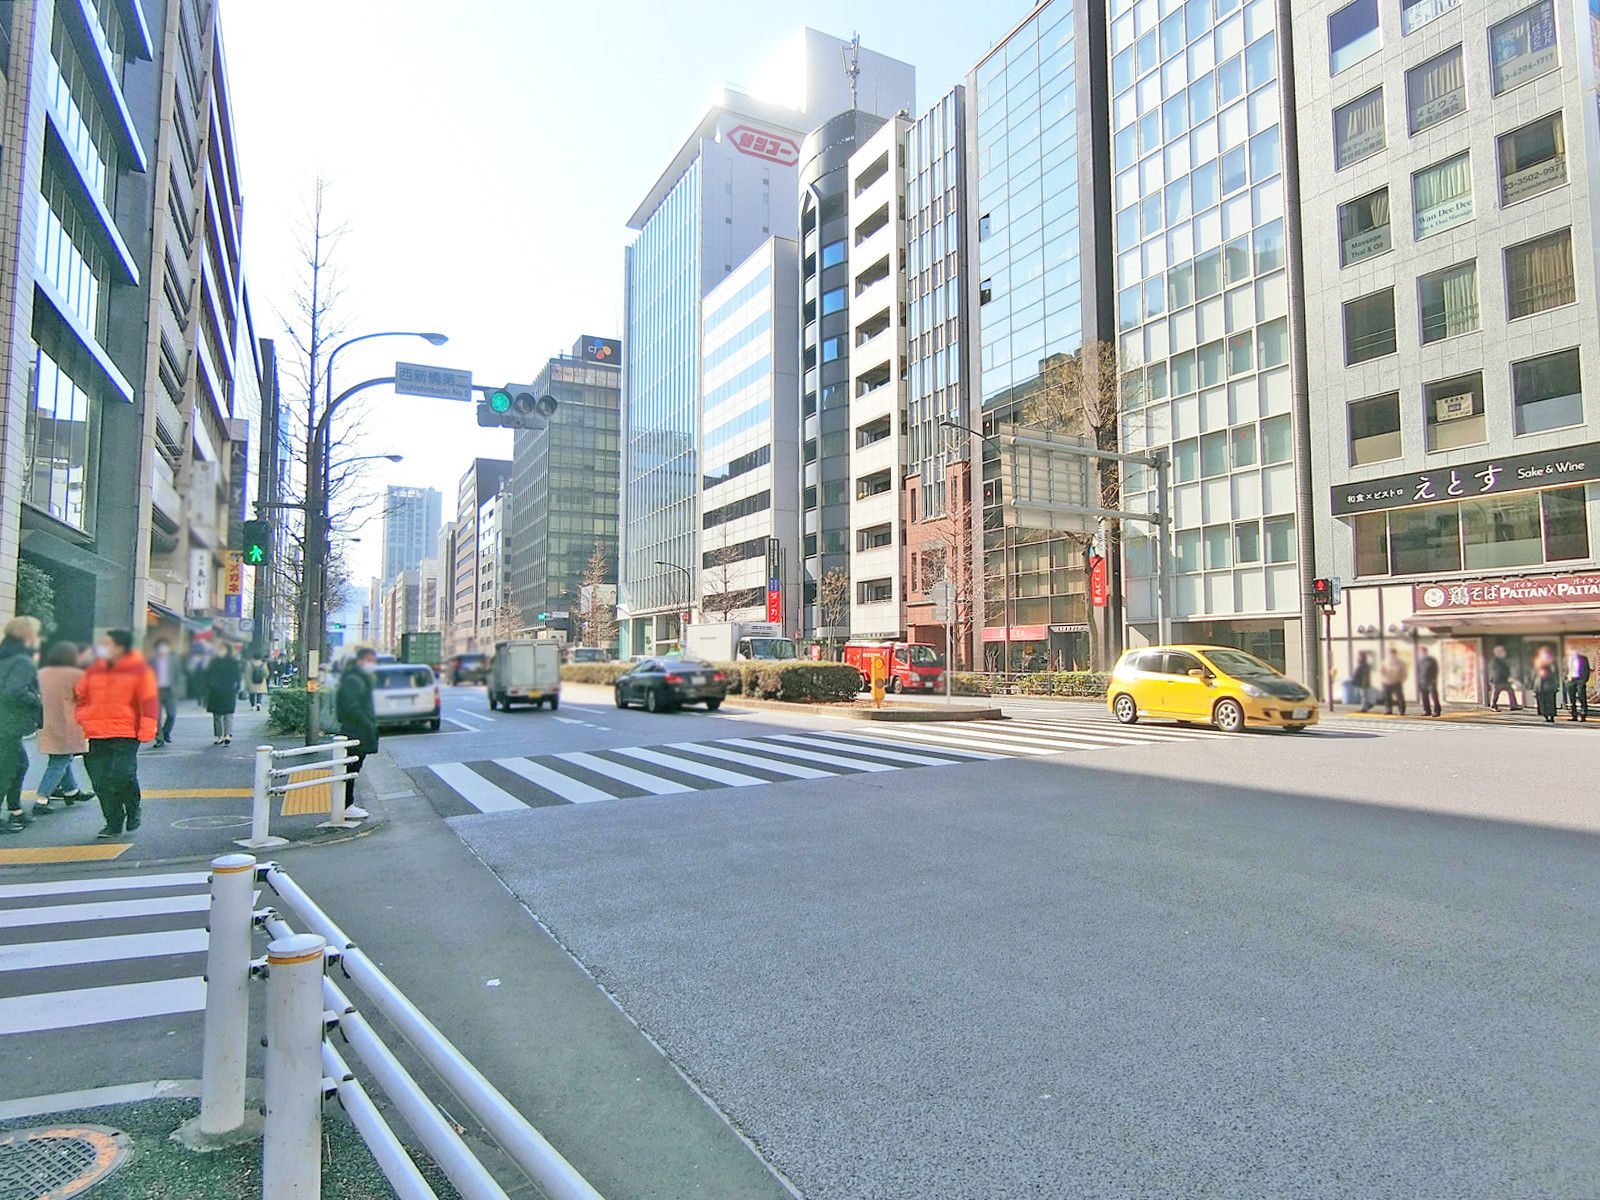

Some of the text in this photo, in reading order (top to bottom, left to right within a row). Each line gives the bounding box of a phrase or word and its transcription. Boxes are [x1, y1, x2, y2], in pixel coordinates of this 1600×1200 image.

[740, 132, 792, 156] サンコー
[1351, 234, 1382, 249] Massage
[399, 367, 469, 388] 西新橋第二
[1517, 460, 1586, 480] Sake & Wine
[1413, 465, 1503, 501] えとす
[1557, 583, 1600, 596] PAITA
